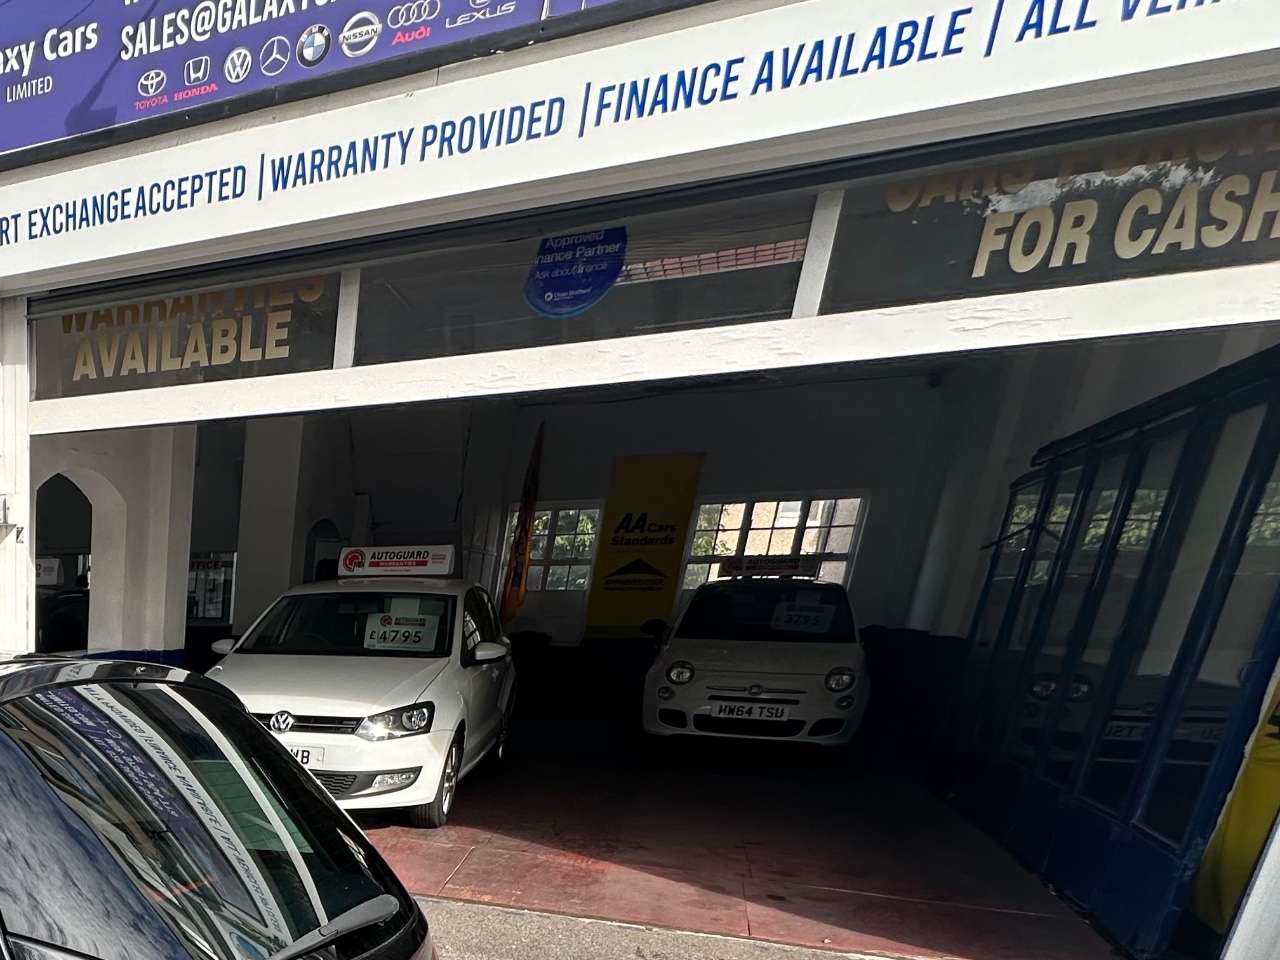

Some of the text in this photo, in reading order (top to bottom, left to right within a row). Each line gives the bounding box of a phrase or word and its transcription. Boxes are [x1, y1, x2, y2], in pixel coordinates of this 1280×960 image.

[445, 3, 516, 29] LEXUS
[43, 22, 98, 61] Cars
[341, 26, 380, 45] NISSAN
[392, 27, 431, 45] Audi
[6, 75, 53, 103] LIMITED
[173, 83, 218, 102] HONDA
[271, 127, 415, 192] WARRANTY
[419, 95, 566, 163] PROVIDED
[595, 56, 746, 127] FINANCE
[750, 6, 973, 96] AVAILABLE
[134, 97, 169, 111] TOYOTA
[971, 171, 1280, 278] FOR CASH
[545, 230, 605, 250] Approved
[576, 242, 623, 258] Partner
[72, 308, 293, 382] AVAILABLE
[613, 512, 649, 533] AA
[370, 550, 430, 560] AUTOGUARD
[758, 706, 785, 719] TSU
